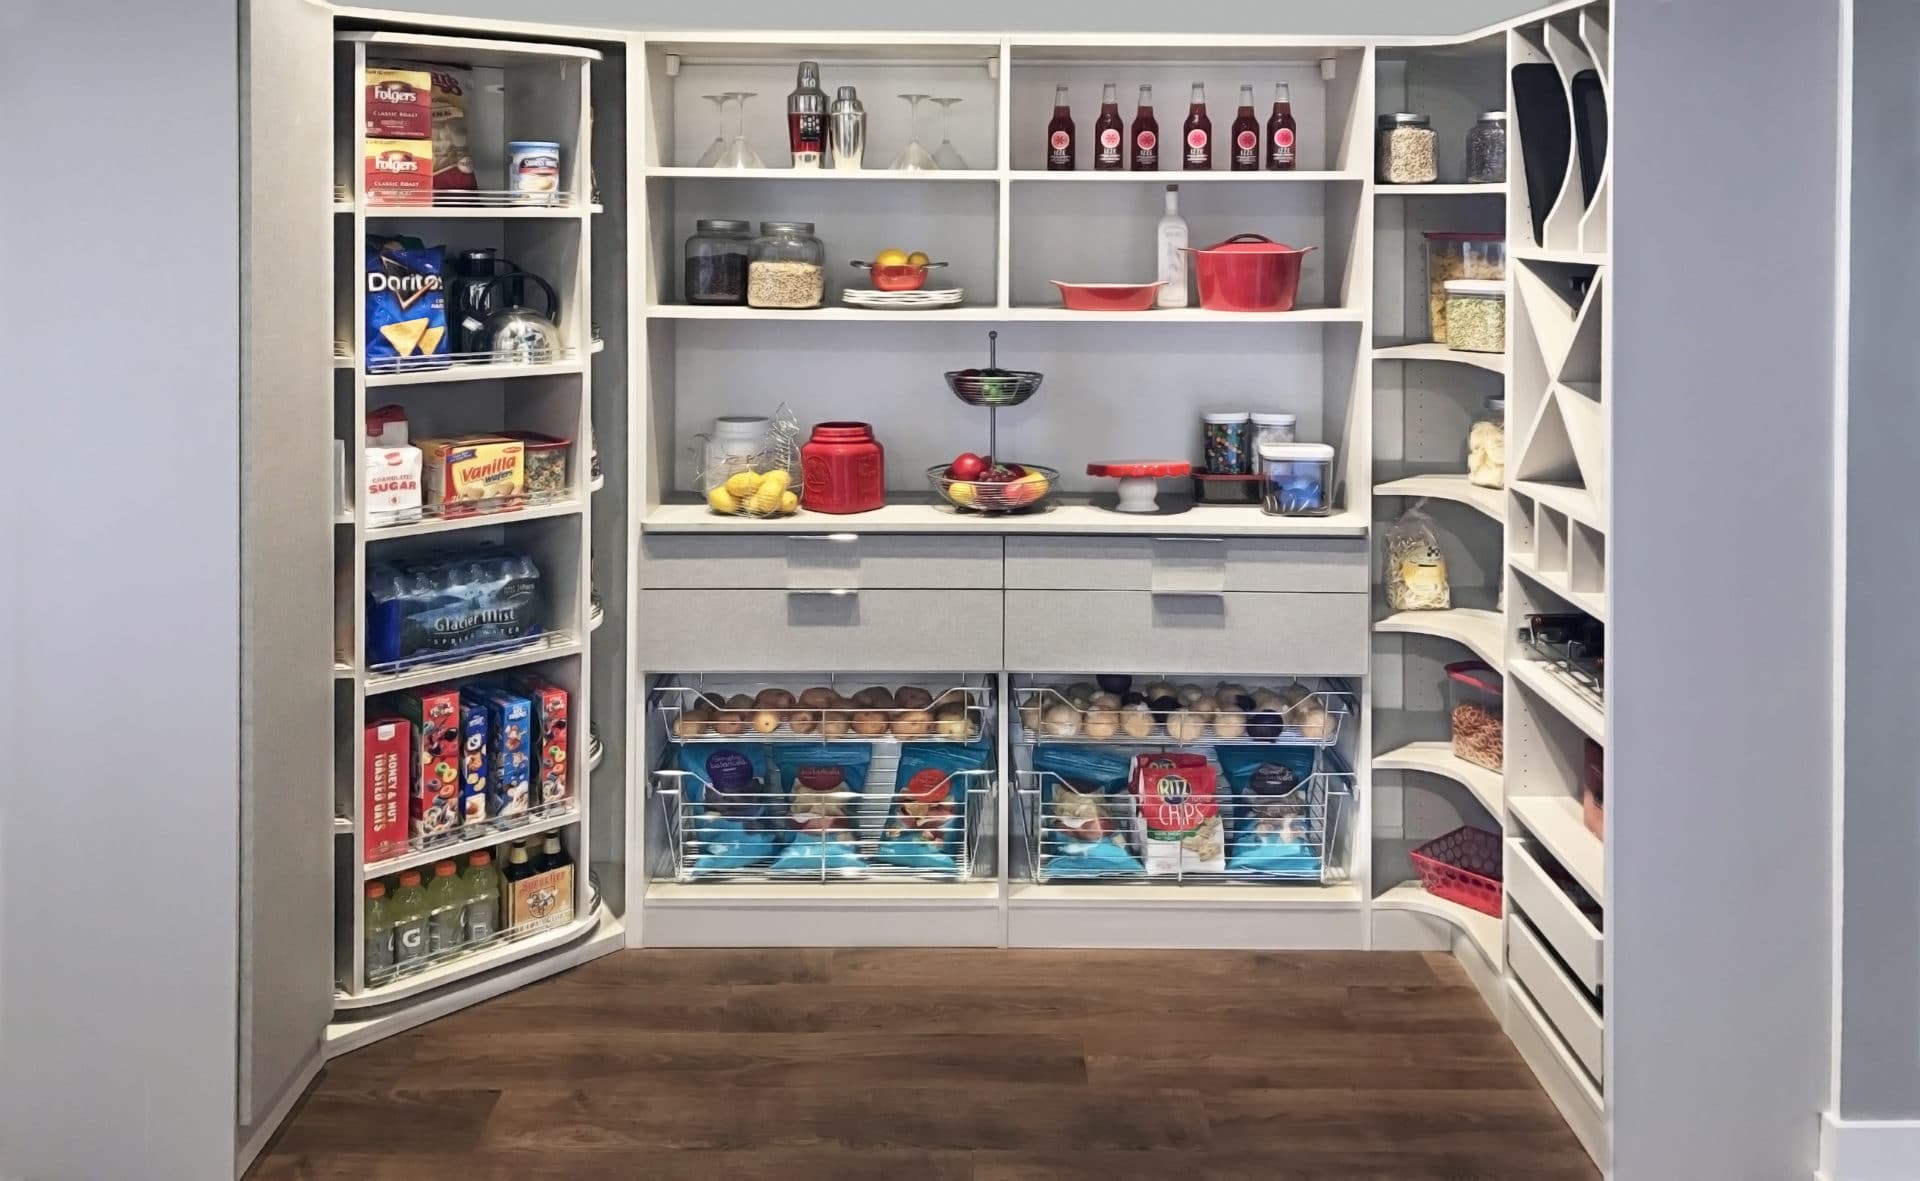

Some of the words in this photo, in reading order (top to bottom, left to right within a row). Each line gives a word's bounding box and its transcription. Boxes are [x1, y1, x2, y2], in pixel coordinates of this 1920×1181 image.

[375, 85, 416, 104] Folgers
[375, 155, 418, 173] Folgers
[462, 455, 516, 483] Vanilla
[368, 481, 417, 494] SUGAR
[434, 615, 478, 632] Glacier
[387, 753, 398, 789] HONEY
[387, 791, 397, 800] &
[1160, 778, 1189, 798] RITZ
[387, 801, 397, 823] NUT
[402, 927, 421, 948] G
